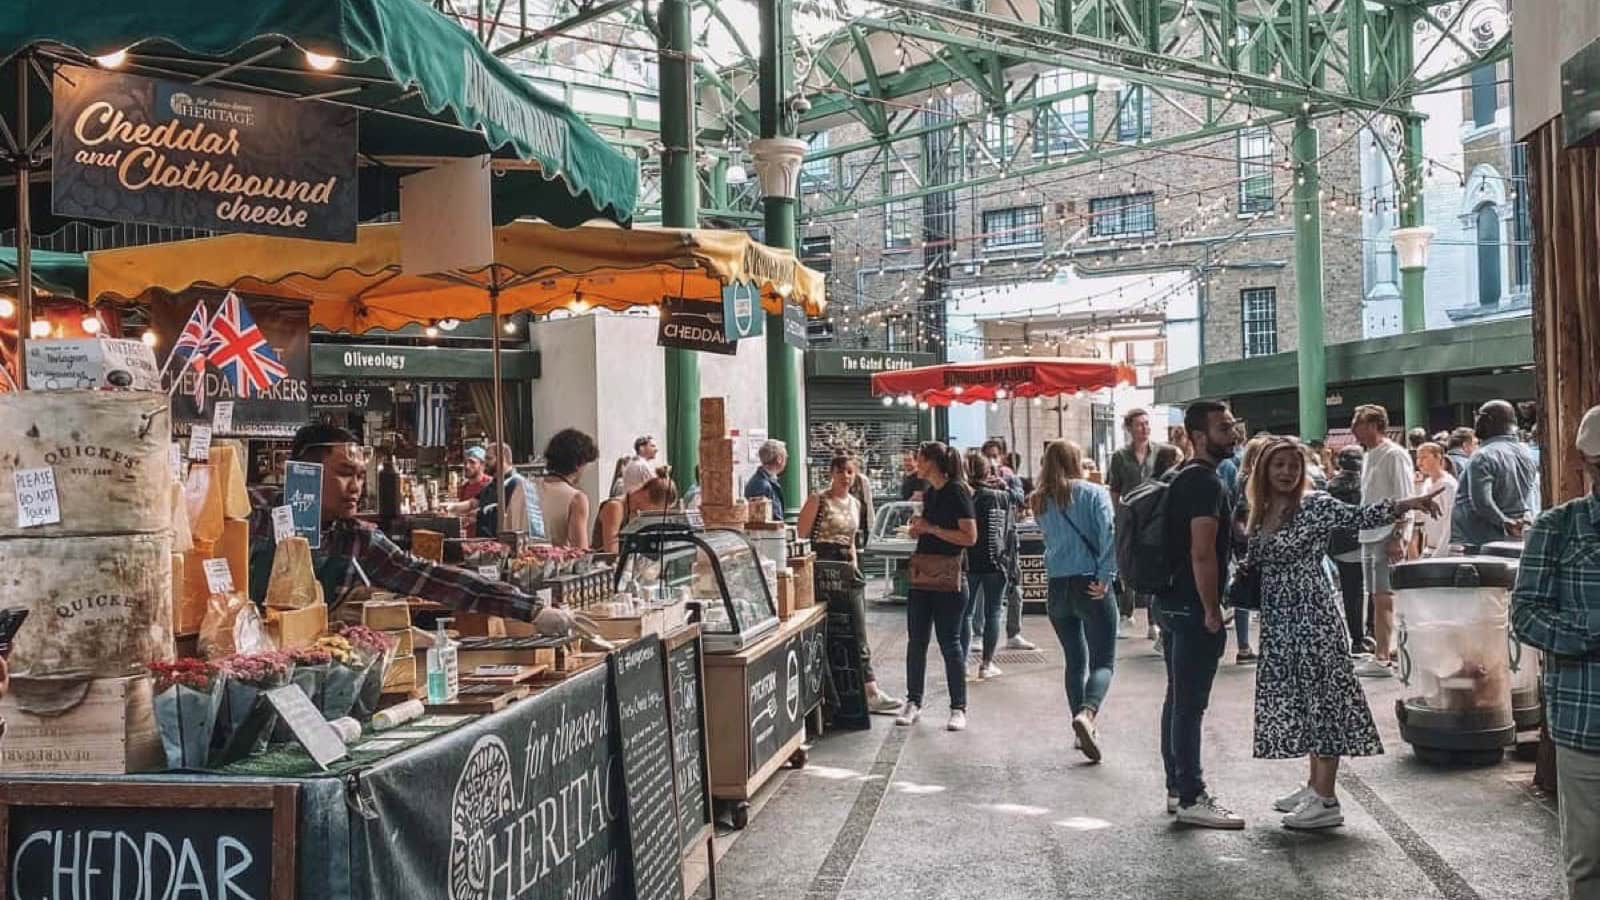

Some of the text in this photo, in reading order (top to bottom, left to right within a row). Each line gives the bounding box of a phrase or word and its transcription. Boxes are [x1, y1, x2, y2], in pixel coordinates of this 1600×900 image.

[182, 104, 255, 126] HERITAGE
[74, 102, 241, 156] Cheddar
[74, 146, 337, 204] and Clothbound
[215, 195, 308, 228] cheese
[344, 351, 405, 370] Oliveology
[842, 356, 857, 370] The
[885, 357, 913, 370] Garden
[157, 369, 237, 398] CHEDA
[16, 471, 53, 488] PLEASE
[19, 488, 54, 506] DO NOT
[55, 594, 142, 618] QUICKE
[517, 720, 549, 809] for
[12, 830, 257, 900] CHEDDAR
